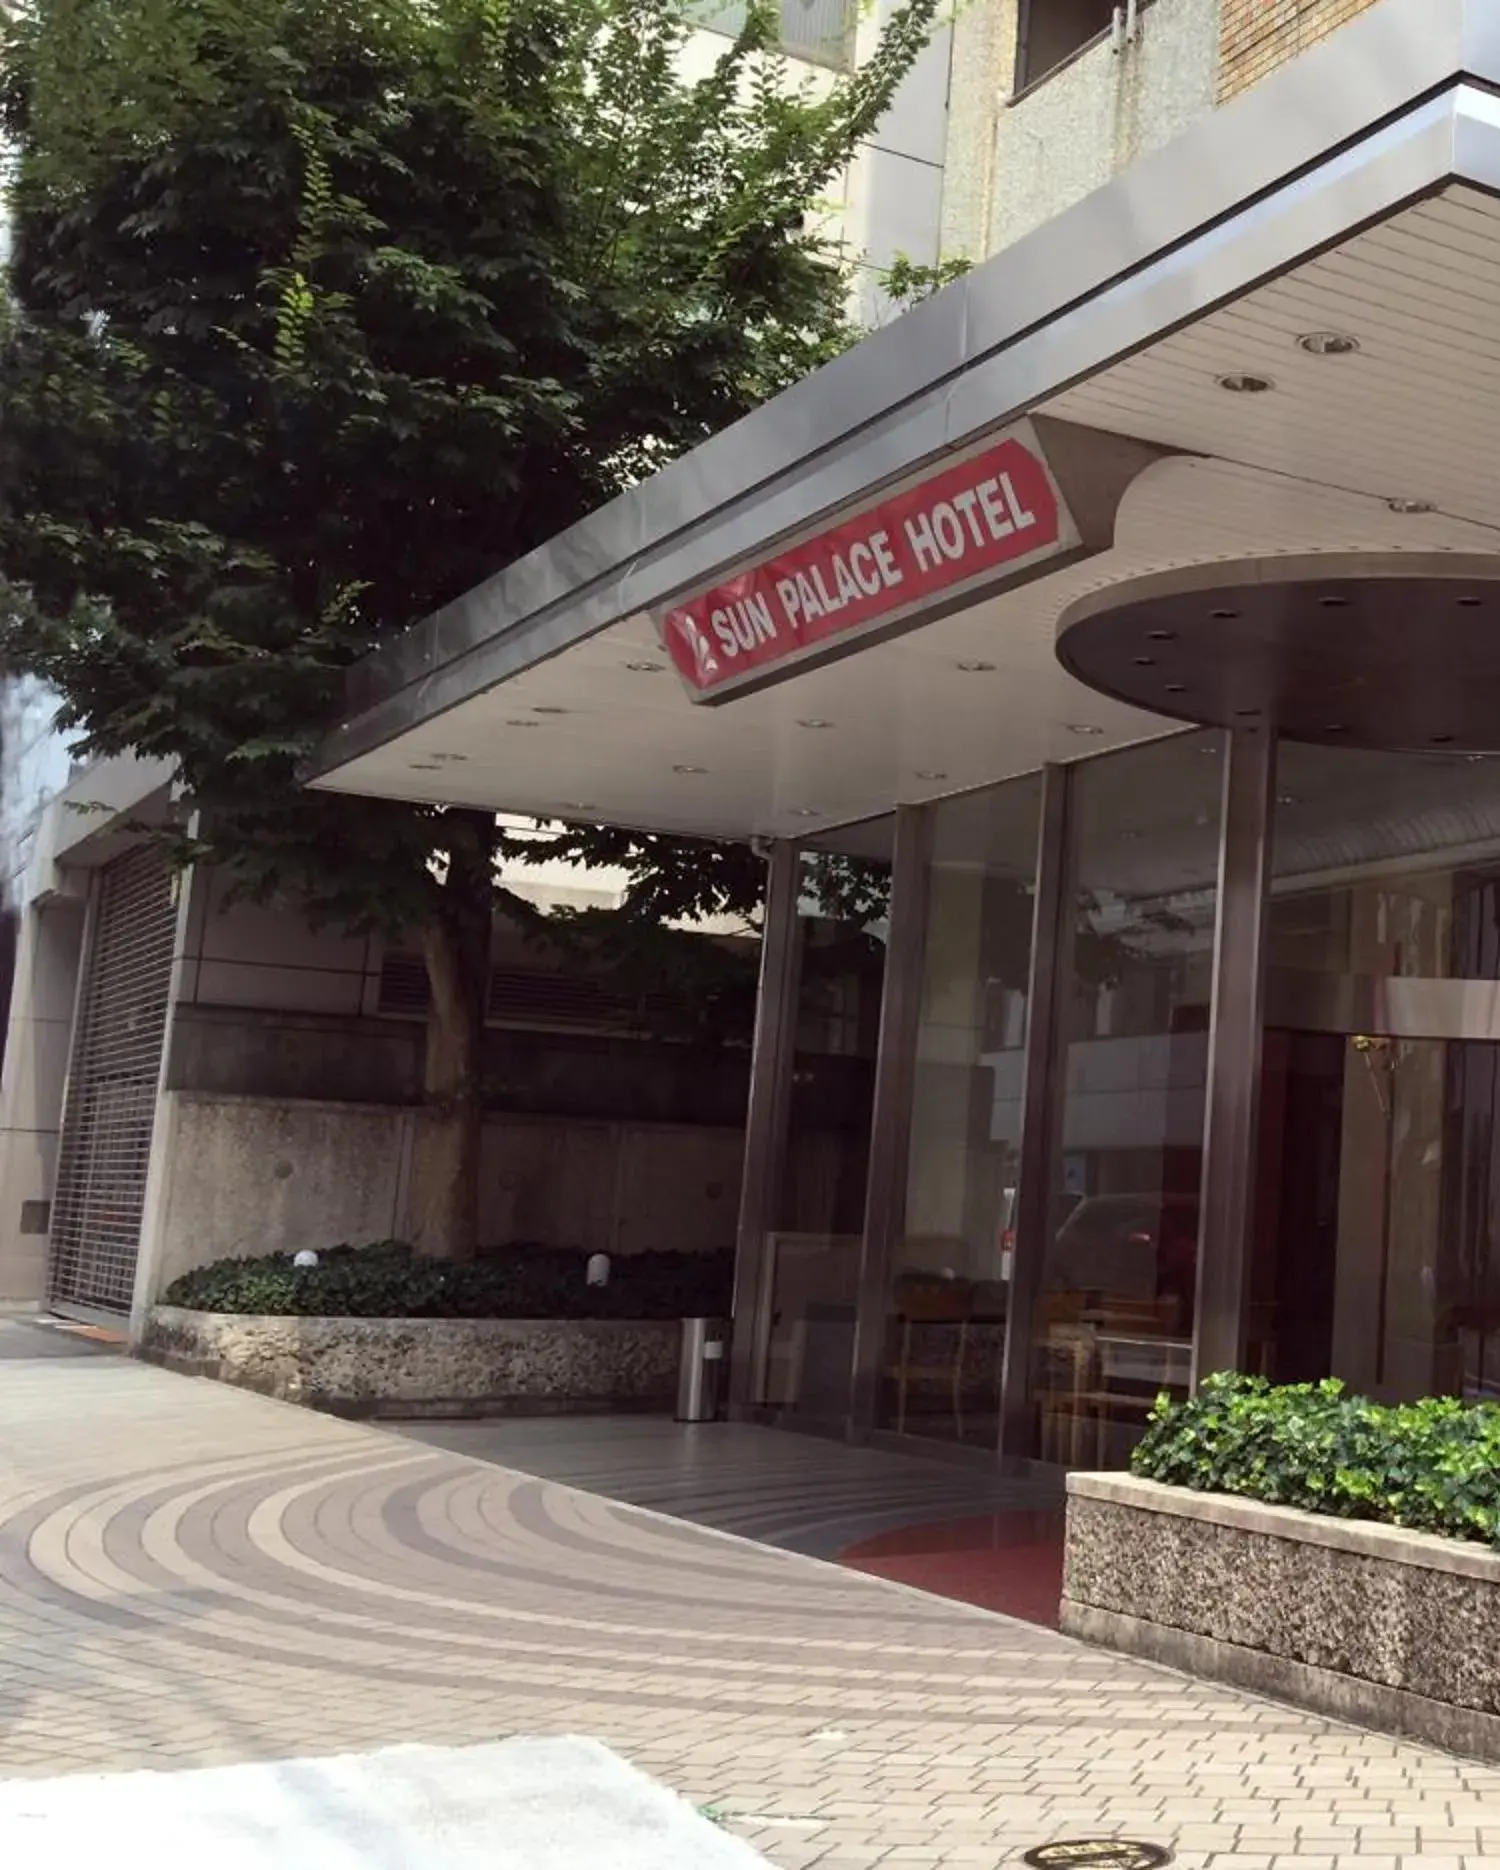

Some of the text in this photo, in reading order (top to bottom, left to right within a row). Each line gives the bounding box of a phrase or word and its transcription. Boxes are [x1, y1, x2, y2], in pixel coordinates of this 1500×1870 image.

[711, 472, 1035, 658] SUN PALACE HOTEL
